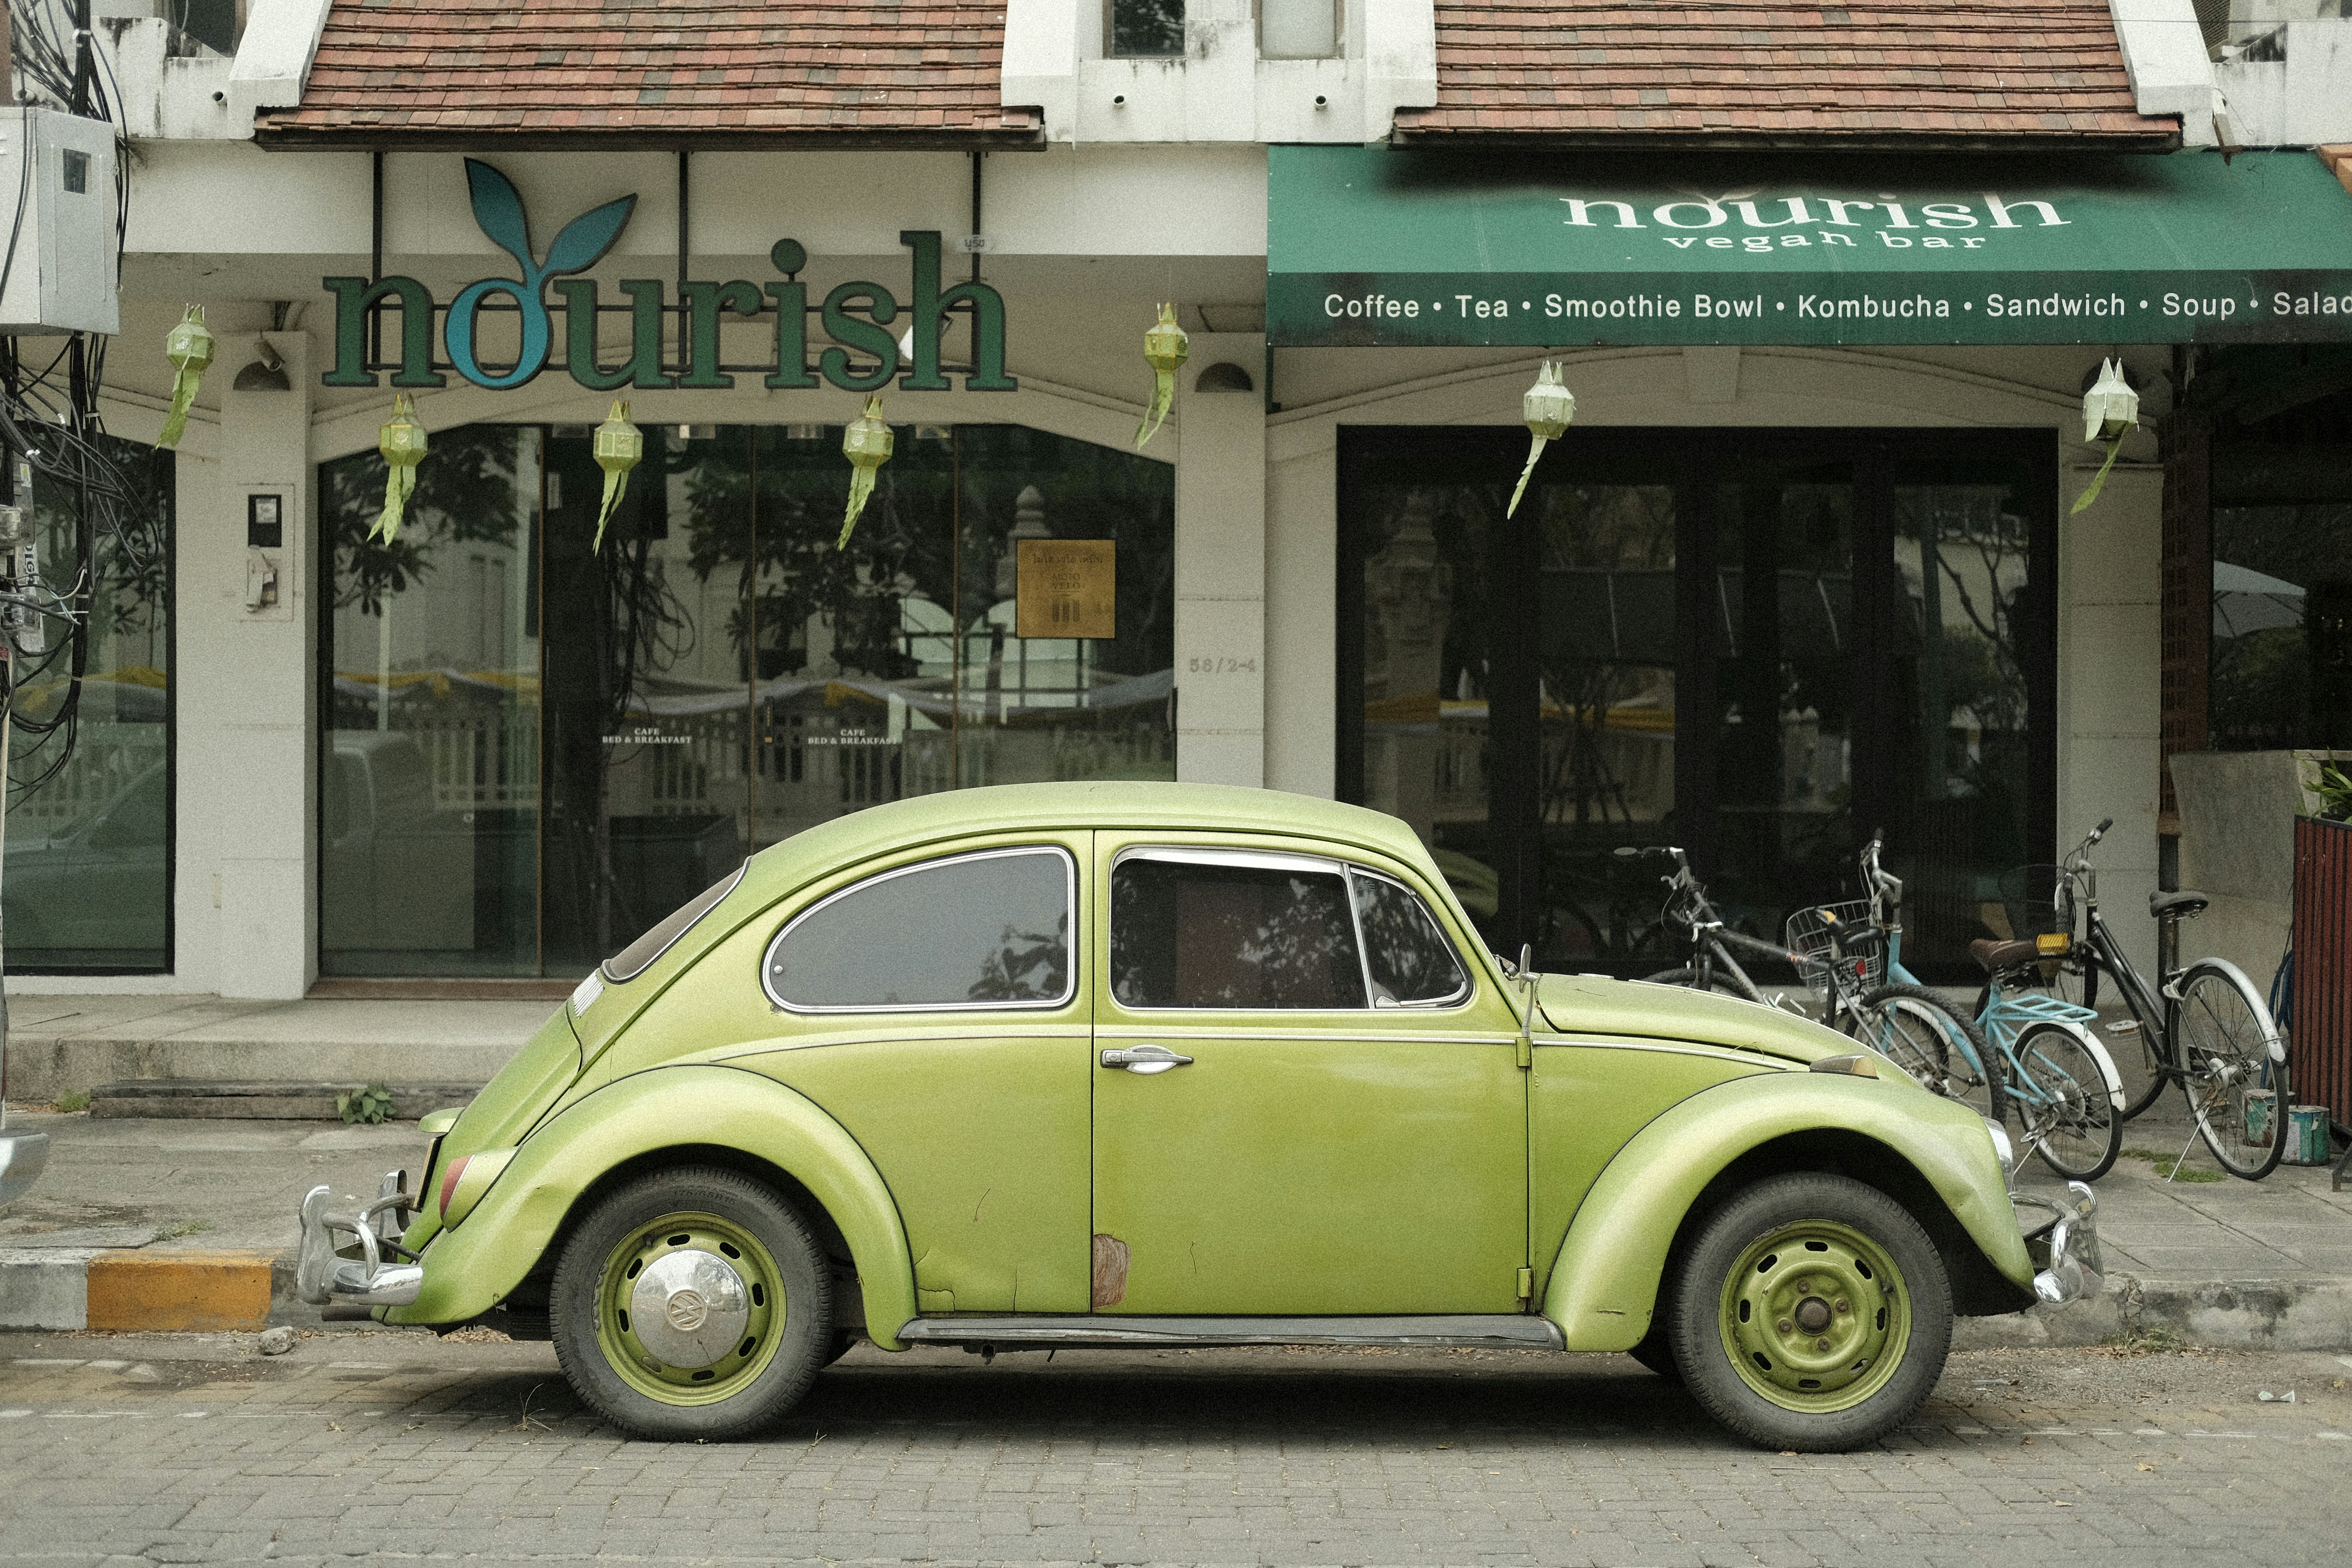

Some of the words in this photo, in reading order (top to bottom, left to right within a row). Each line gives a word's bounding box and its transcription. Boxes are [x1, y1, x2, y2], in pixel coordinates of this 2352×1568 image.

[1559, 191, 2072, 229] nourish
[1663, 231, 1857, 252] vegan
[1876, 231, 1986, 248] bar
[322, 230, 1018, 391] nourish
[1325, 294, 1419, 318] Coffee
[1455, 295, 1508, 318] Tea
[1545, 294, 1681, 318] Smoothie
[1695, 294, 1762, 318] Bowl
[1799, 294, 1949, 318] Kombucha
[1987, 293, 2125, 317] Sandwich
[2162, 292, 2236, 320] Soup
[634, 735, 692, 744] BREAKFAST
